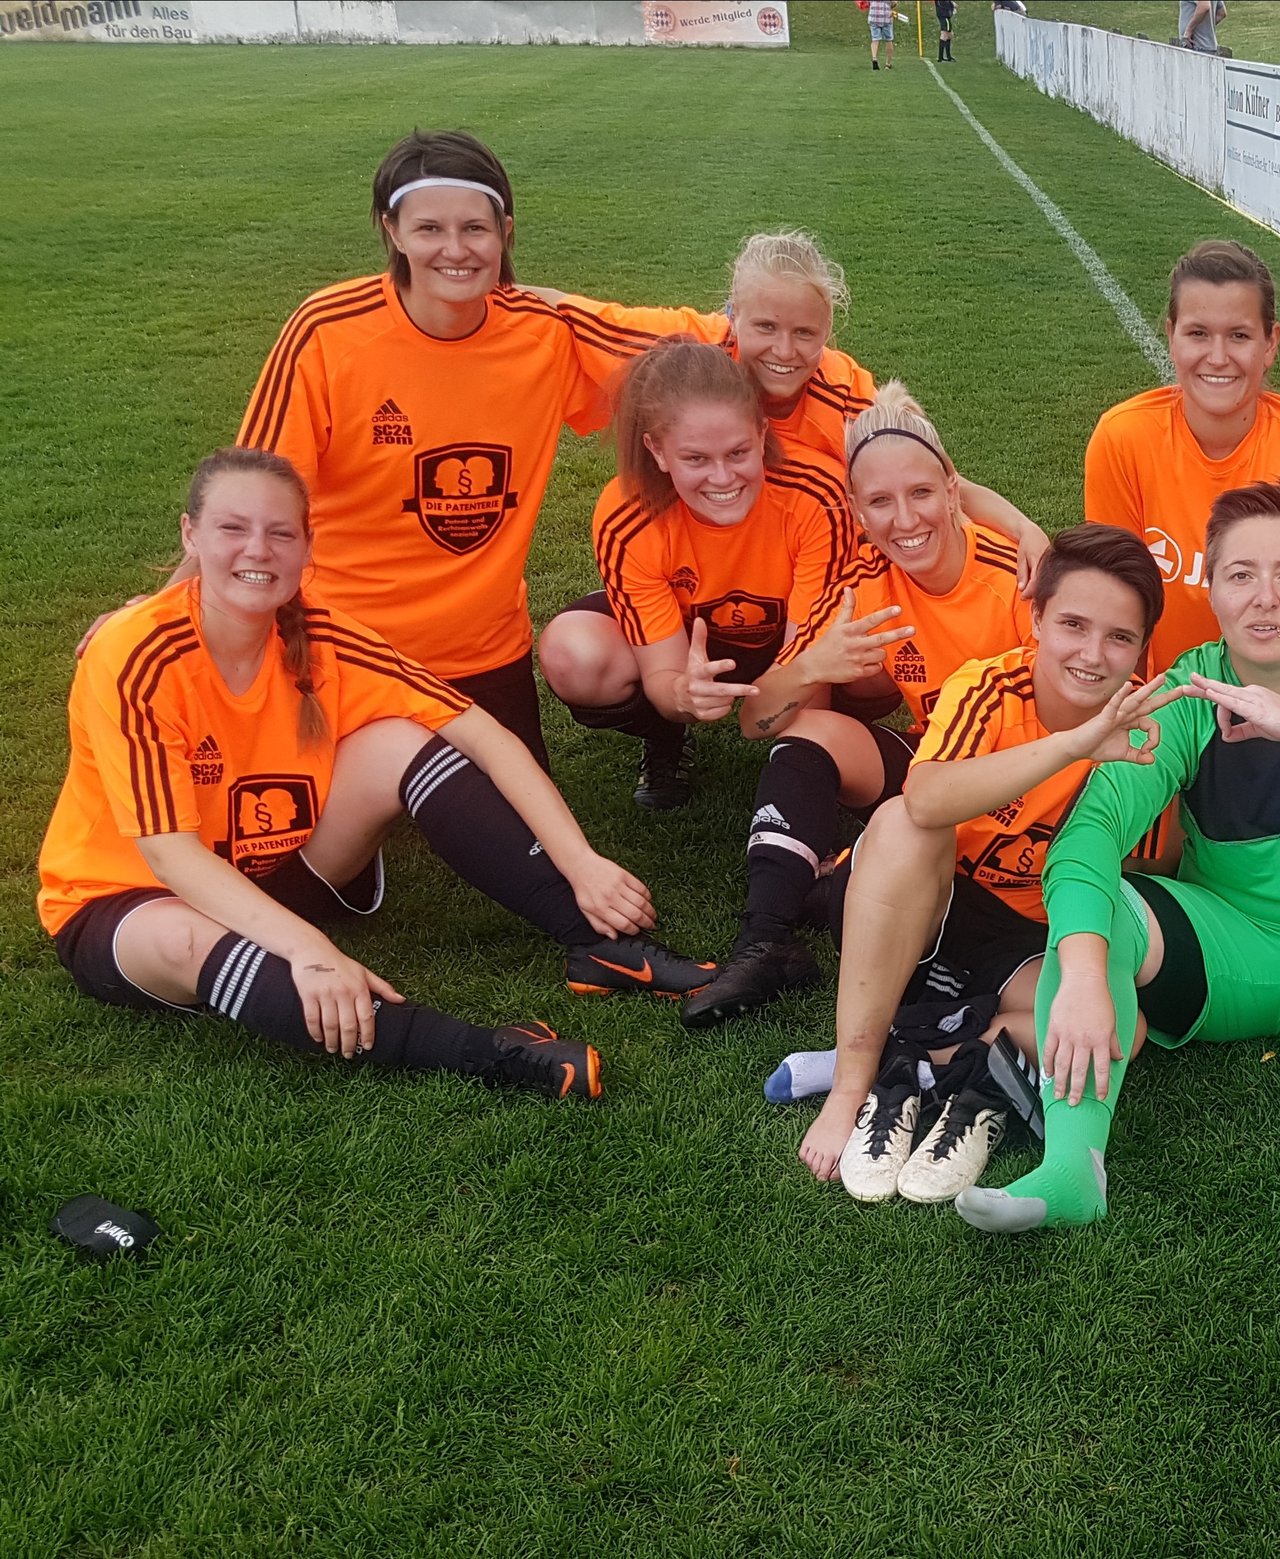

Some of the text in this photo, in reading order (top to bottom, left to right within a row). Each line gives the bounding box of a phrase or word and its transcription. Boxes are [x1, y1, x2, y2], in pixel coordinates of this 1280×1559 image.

[152, 6, 190, 20] Alles
[679, 16, 711, 27] Werde
[105, 23, 193, 39] für den Bau
[371, 413, 409, 423] adidas
[373, 424, 412, 437] SC24
[426, 500, 499, 512] DIE PATENTERIE
[894, 653, 925, 662] adidas
[894, 664, 926, 675] SC24
[750, 815, 791, 833] didas
